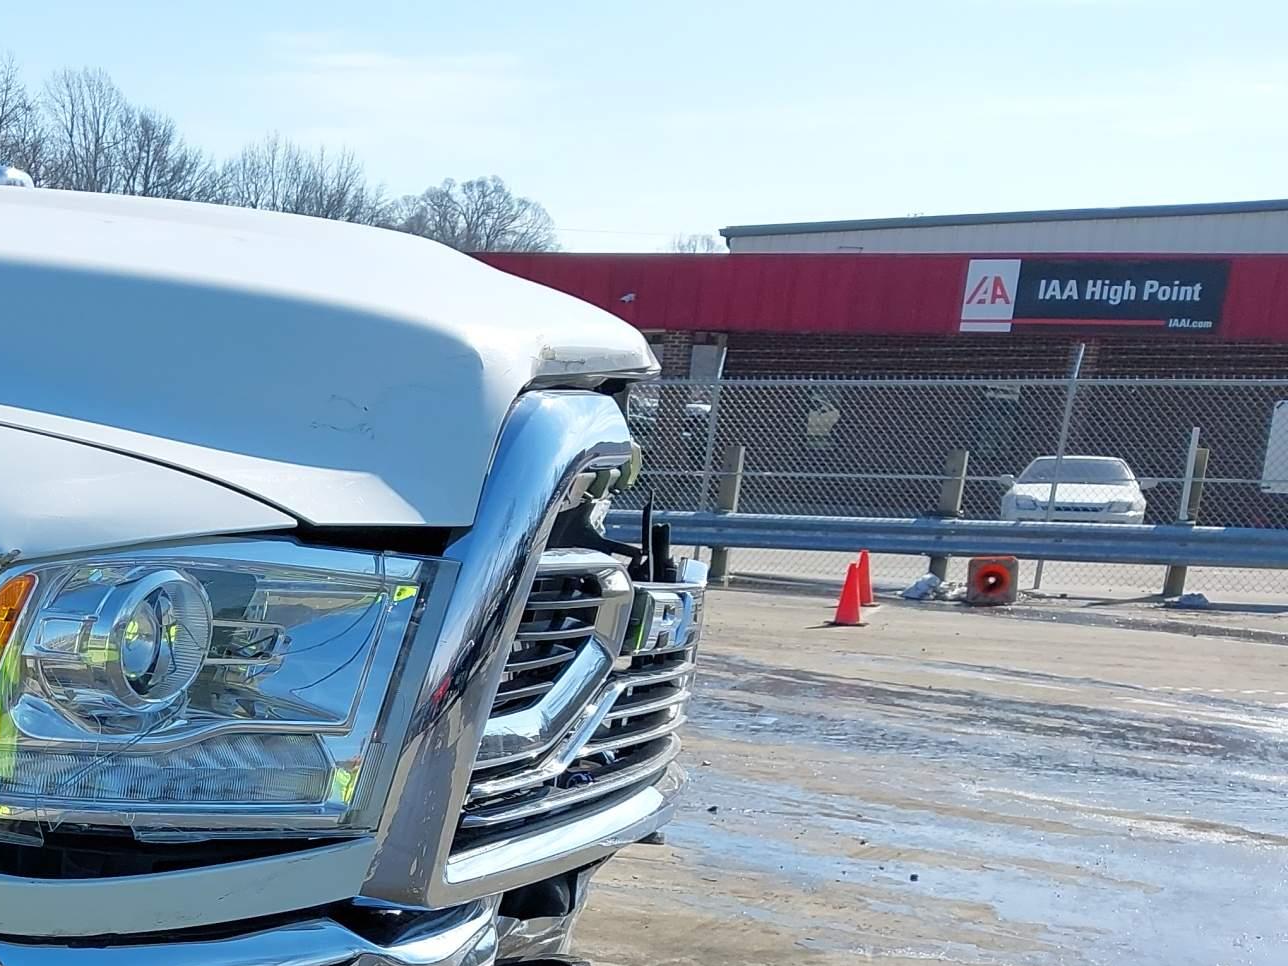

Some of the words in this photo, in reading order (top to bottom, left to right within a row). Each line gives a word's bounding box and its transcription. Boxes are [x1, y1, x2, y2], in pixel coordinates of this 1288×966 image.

[1038, 278, 1079, 301] IAA
[1085, 279, 1137, 305] High
[1143, 279, 1203, 302] Point
[1168, 317, 1213, 329] IAAI.com
